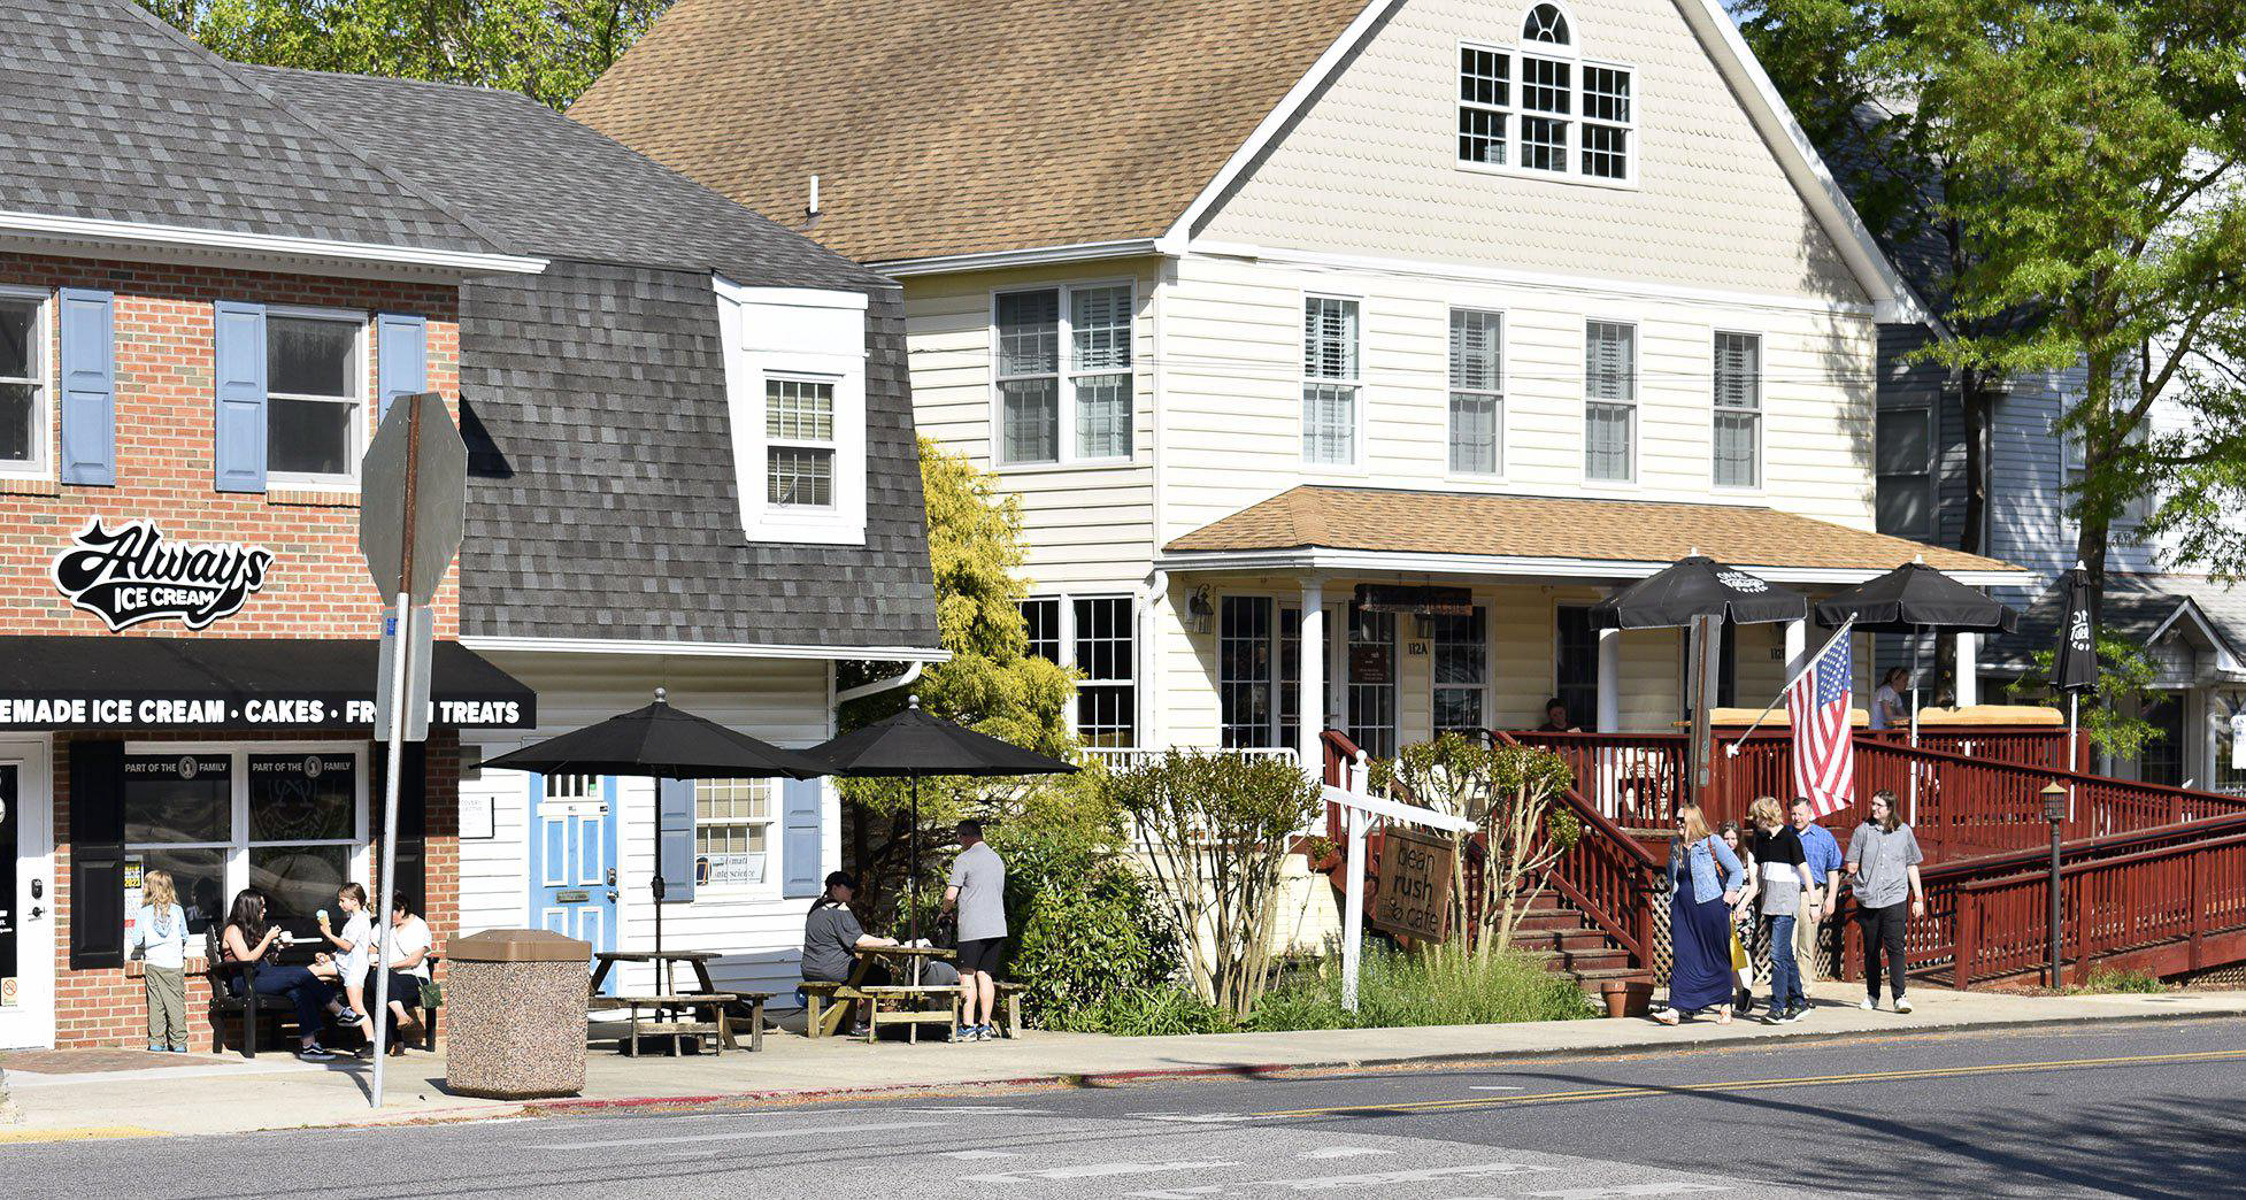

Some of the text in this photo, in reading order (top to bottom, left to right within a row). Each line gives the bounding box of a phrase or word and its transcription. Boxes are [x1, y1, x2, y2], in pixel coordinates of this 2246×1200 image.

[57, 518, 271, 593] Always
[114, 586, 215, 614] ICE CREAM
[1408, 642, 1428, 655] 112A
[92, 699, 133, 723] ICE
[138, 699, 225, 723] CREAM
[244, 699, 325, 724] CAKES
[439, 701, 520, 724] TREATS
[124, 763, 227, 772] PART OF THE FAMILY
[252, 762, 351, 771] PART OF THE FAMILY
[1398, 841, 1435, 873] bean
[1394, 875, 1433, 902] rush
[1406, 904, 1438, 932] cafe
